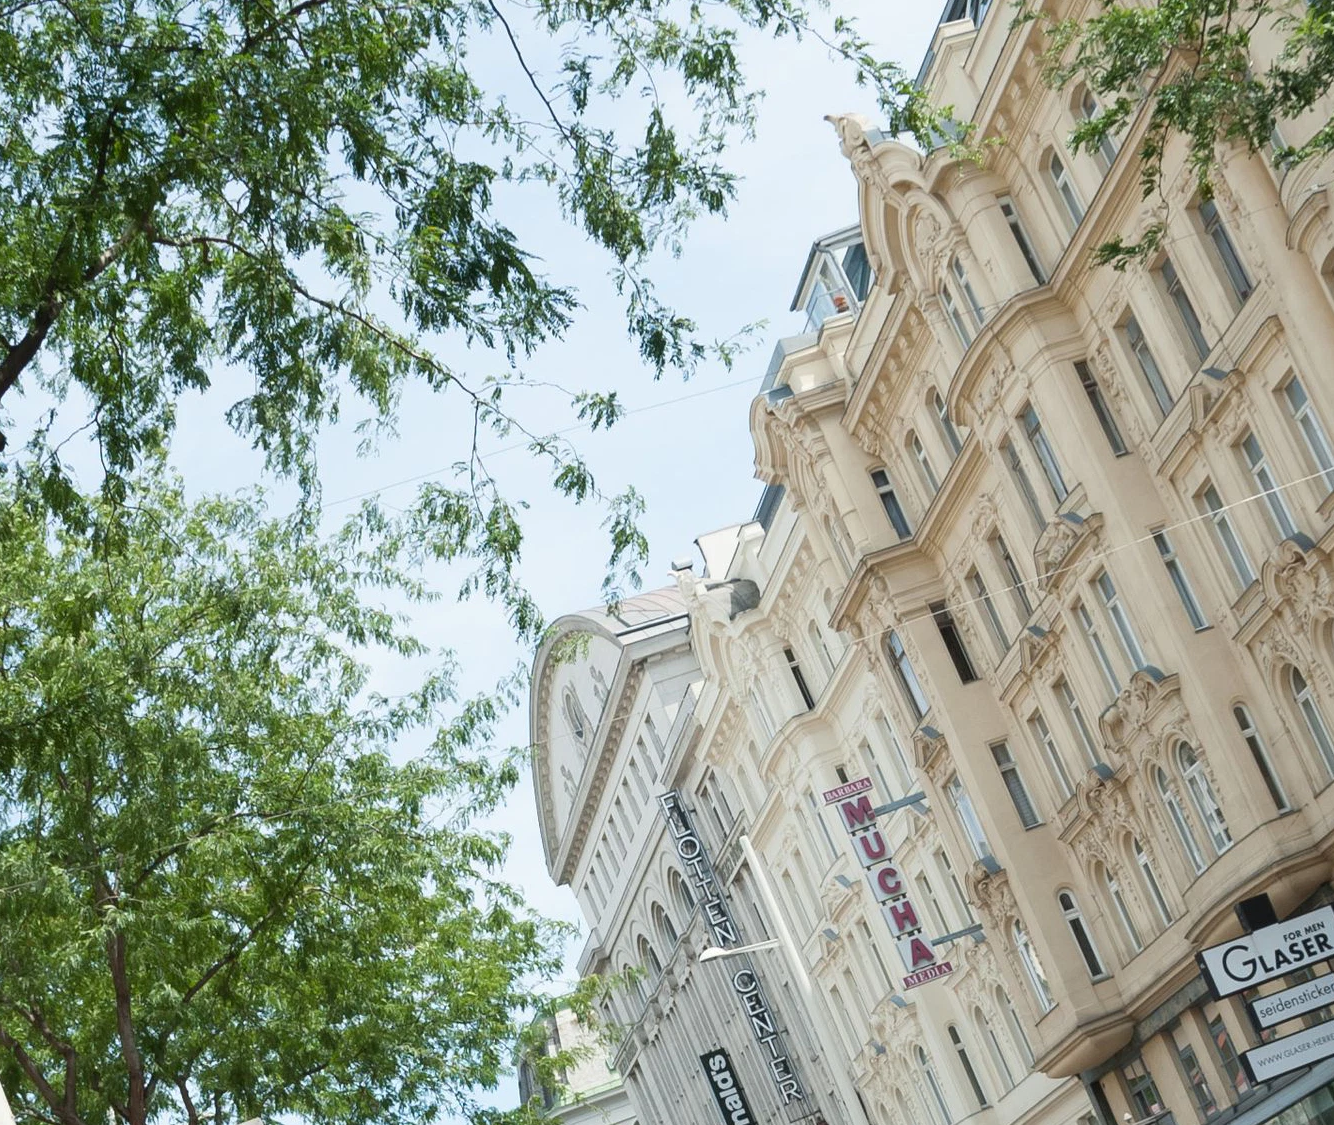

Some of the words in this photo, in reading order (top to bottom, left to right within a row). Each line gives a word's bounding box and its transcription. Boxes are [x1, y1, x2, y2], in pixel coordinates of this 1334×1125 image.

[824, 778, 872, 801] BARBARA
[840, 795, 936, 967] MUCHA
[660, 791, 736, 947] FLOTTEN
[733, 969, 803, 1105] CENTER
[1282, 929, 1302, 943] FOR
[1304, 921, 1326, 936] MEN
[904, 964, 951, 989] MEDIA
[1222, 932, 1334, 983] GLASER
